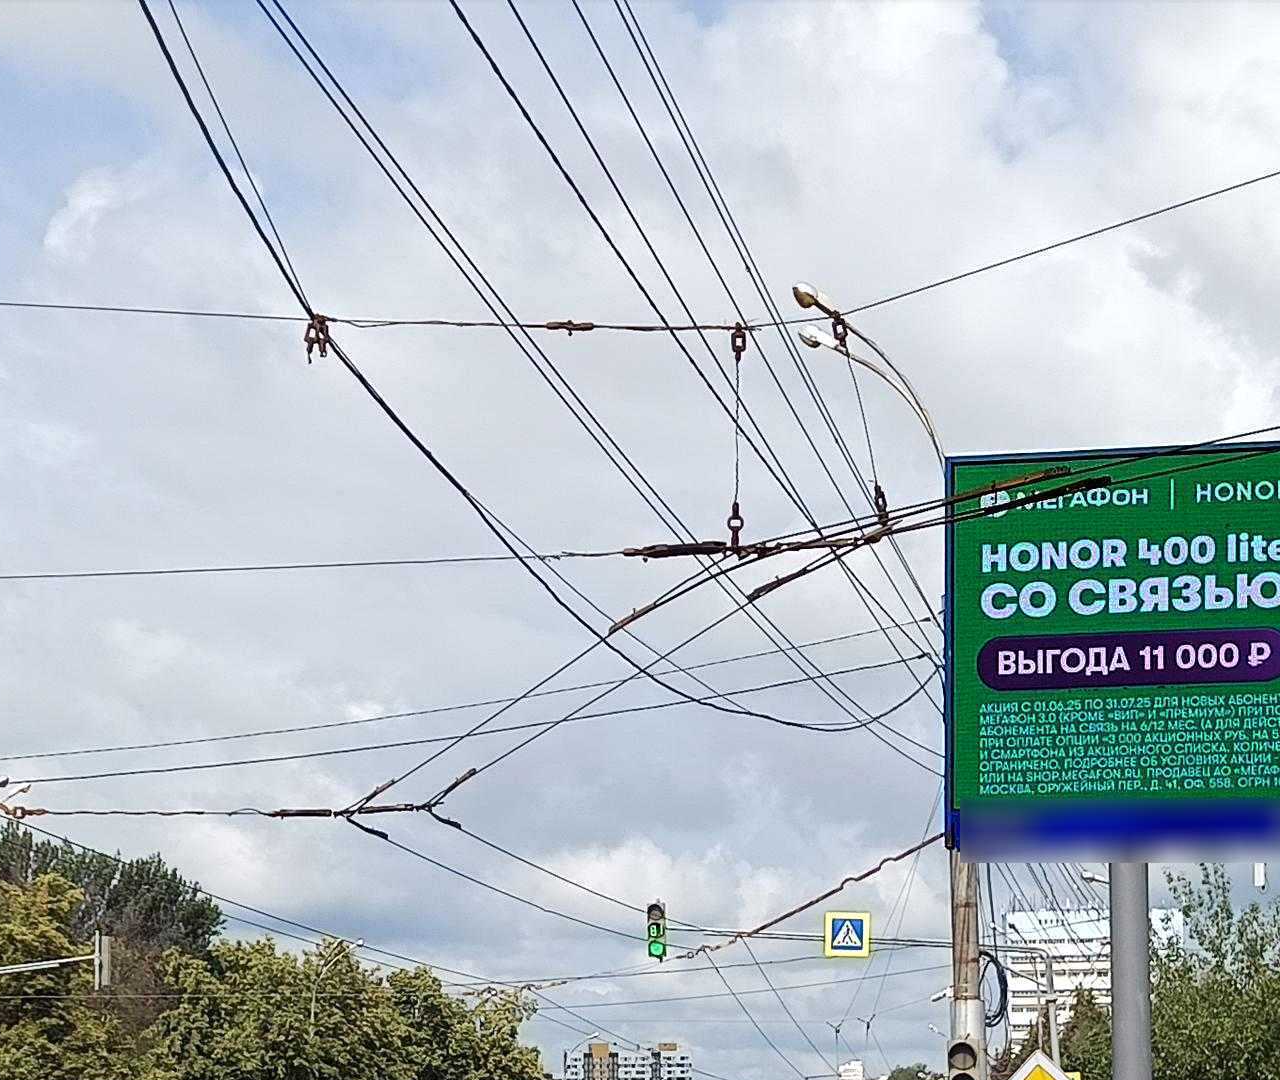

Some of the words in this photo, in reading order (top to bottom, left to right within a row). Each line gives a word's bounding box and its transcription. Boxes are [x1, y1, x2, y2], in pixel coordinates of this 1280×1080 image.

[981, 539, 1127, 573] HONOR
[1138, 535, 1216, 566] 400
[980, 581, 1057, 619] СО
[997, 646, 1131, 676] ВЫГОДА
[1139, 645, 1164, 670] 11
[1175, 643, 1240, 669] 000
[1247, 641, 1271, 667] ₽
[980, 702, 1018, 713] АКЦИЯ
[1021, 701, 1032, 712] С
[1085, 699, 1104, 709] ПО
[1106, 698, 1151, 709] 31.07.25
[1154, 696, 1178, 708] ДЛЯ
[1182, 695, 1225, 706] НОВЫХ
[980, 713, 1036, 725] МЕГАФОН
[1039, 712, 1056, 723] 3.0
[1148, 709, 1156, 719] И
[1238, 706, 1263, 717] ПРИ
[980, 725, 1057, 736] АБОНЕМЕНТА
[1060, 724, 1076, 735] НА
[1079, 722, 1118, 733] СВЯЗЬ
[1121, 721, 1137, 732] НА
[1215, 718, 1240, 730] ДЛЯ
[980, 738, 1003, 748] ПРИ
[1006, 736, 1053, 747] ОПЛАТЕ
[1056, 734, 1099, 746] ОПЦИИ
[1145, 731, 1221, 743] АКЦИОННЫХ
[1252, 729, 1268, 739] НА
[980, 749, 988, 760] И
[990, 747, 1066, 760] СМАРТФОНА
[1069, 746, 1084, 757] ИЗ
[1087, 744, 1172, 756] АКЦИОННОГО
[1064, 756, 1137, 768] ПОДРОБНЕЕ
[1140, 755, 1158, 766] ОБ
[1160, 754, 1227, 766] УСЛОВИЯХ
[1230, 753, 1271, 764] АКЦИИ
[980, 772, 1004, 783] ИЛИ
[1008, 772, 1023, 783] НА
[1147, 766, 1210, 778] ПРОДАВЕЦ
[1213, 765, 1231, 777] АО
[1037, 780, 1114, 794] ОРУЖЕЙНЫЙ
[1237, 776, 1271, 788] ОГРН
